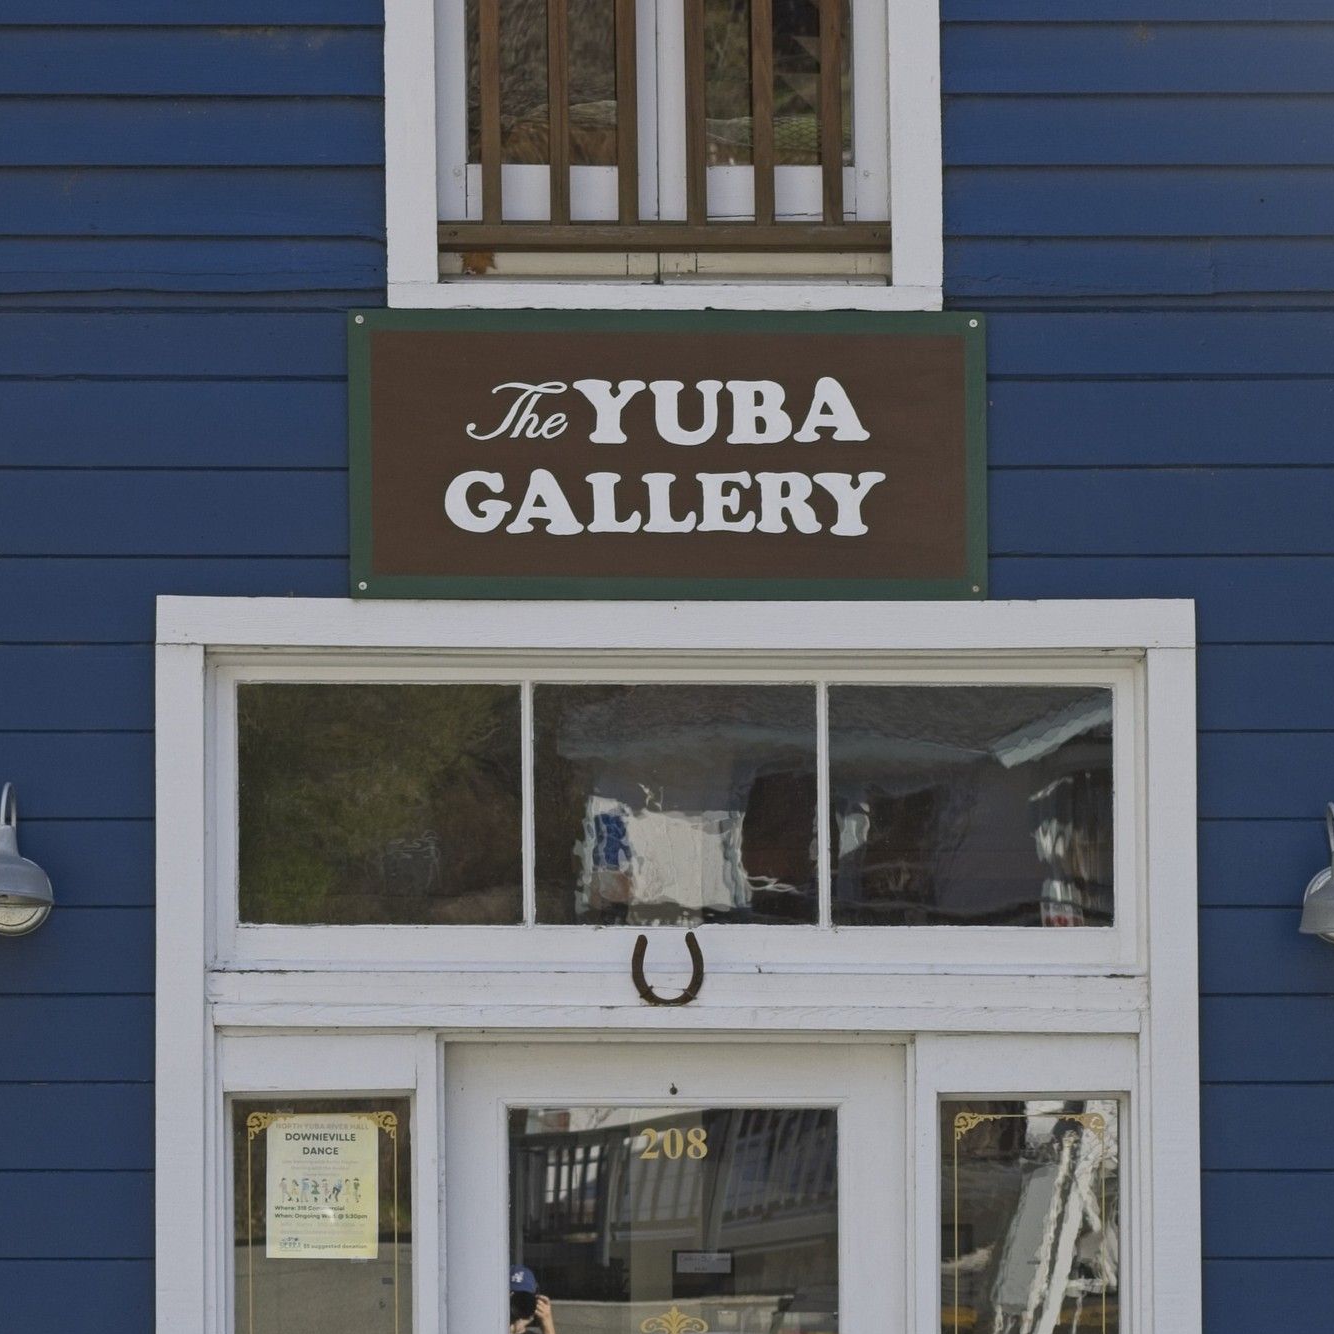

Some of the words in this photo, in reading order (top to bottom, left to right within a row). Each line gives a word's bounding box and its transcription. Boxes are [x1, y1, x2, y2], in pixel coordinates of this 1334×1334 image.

[466, 381, 568, 441] The
[572, 376, 871, 446] YUBA
[443, 468, 886, 537] GALLERY
[284, 1132, 357, 1142] DOWNIEVILLE
[302, 1146, 339, 1156] DANCE
[639, 1127, 708, 1160] 208
